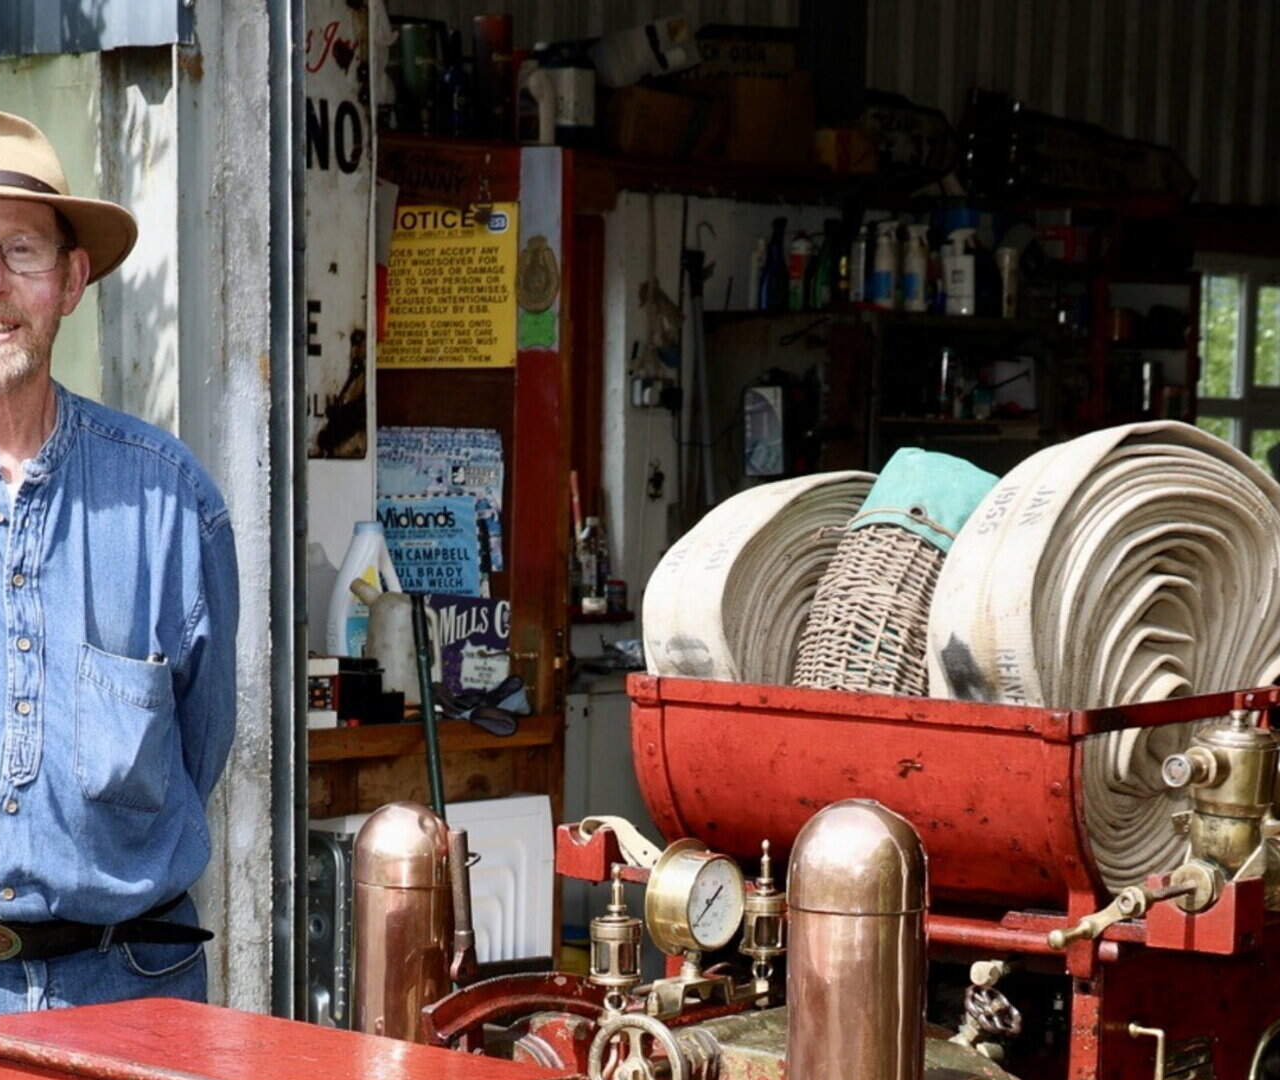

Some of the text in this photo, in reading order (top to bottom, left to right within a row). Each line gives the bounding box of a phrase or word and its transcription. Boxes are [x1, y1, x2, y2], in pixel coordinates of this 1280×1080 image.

[417, 248, 436, 256] NOT
[440, 247, 476, 256] ACCEPT
[480, 246, 499, 255] ANY
[411, 256, 474, 266] WHATSOEVER
[478, 256, 498, 264] FOR
[418, 267, 444, 276] LOSS
[448, 266, 462, 275] OR
[466, 266, 505, 275] DAMAGE
[405, 278, 417, 286] TO
[420, 277, 438, 286] ANY
[442, 276, 482, 285] PERSON
[486, 275, 500, 284] OR
[404, 287, 418, 295] ON
[423, 286, 452, 295] THESE
[395, 296, 434, 305] CAUSED
[436, 294, 508, 305] INTENTIONALLY
[452, 305, 464, 314] BY
[430, 319, 465, 329] COMING
[468, 319, 493, 328] ONTO
[406, 547, 470, 561] CAMPBELL
[417, 566, 463, 578] BRADY
[428, 578, 463, 588] WELCH
